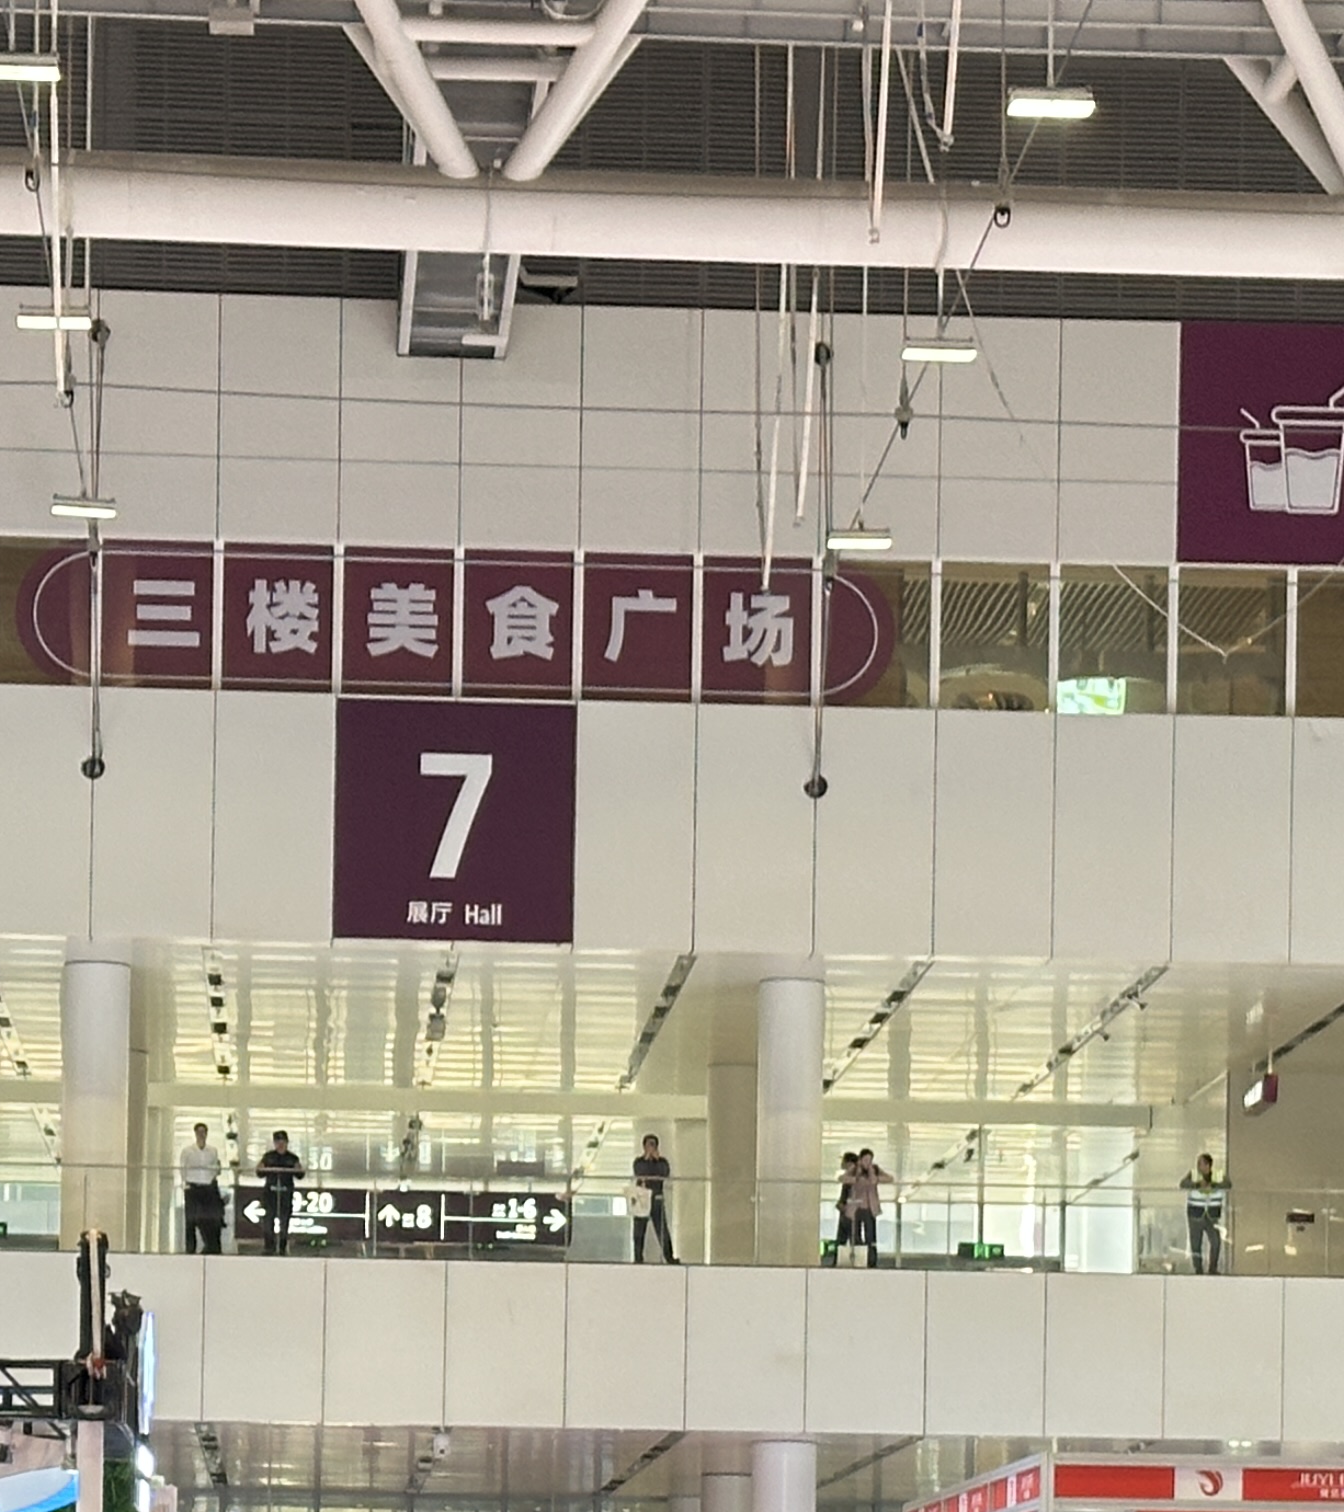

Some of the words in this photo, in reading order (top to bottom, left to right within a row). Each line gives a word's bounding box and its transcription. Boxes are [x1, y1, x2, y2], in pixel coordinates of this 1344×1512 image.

[128, 578, 796, 668] 三楼美食广场
[419, 753, 493, 879] 7
[406, 900, 453, 925] 展厅
[464, 903, 503, 926] Hall
